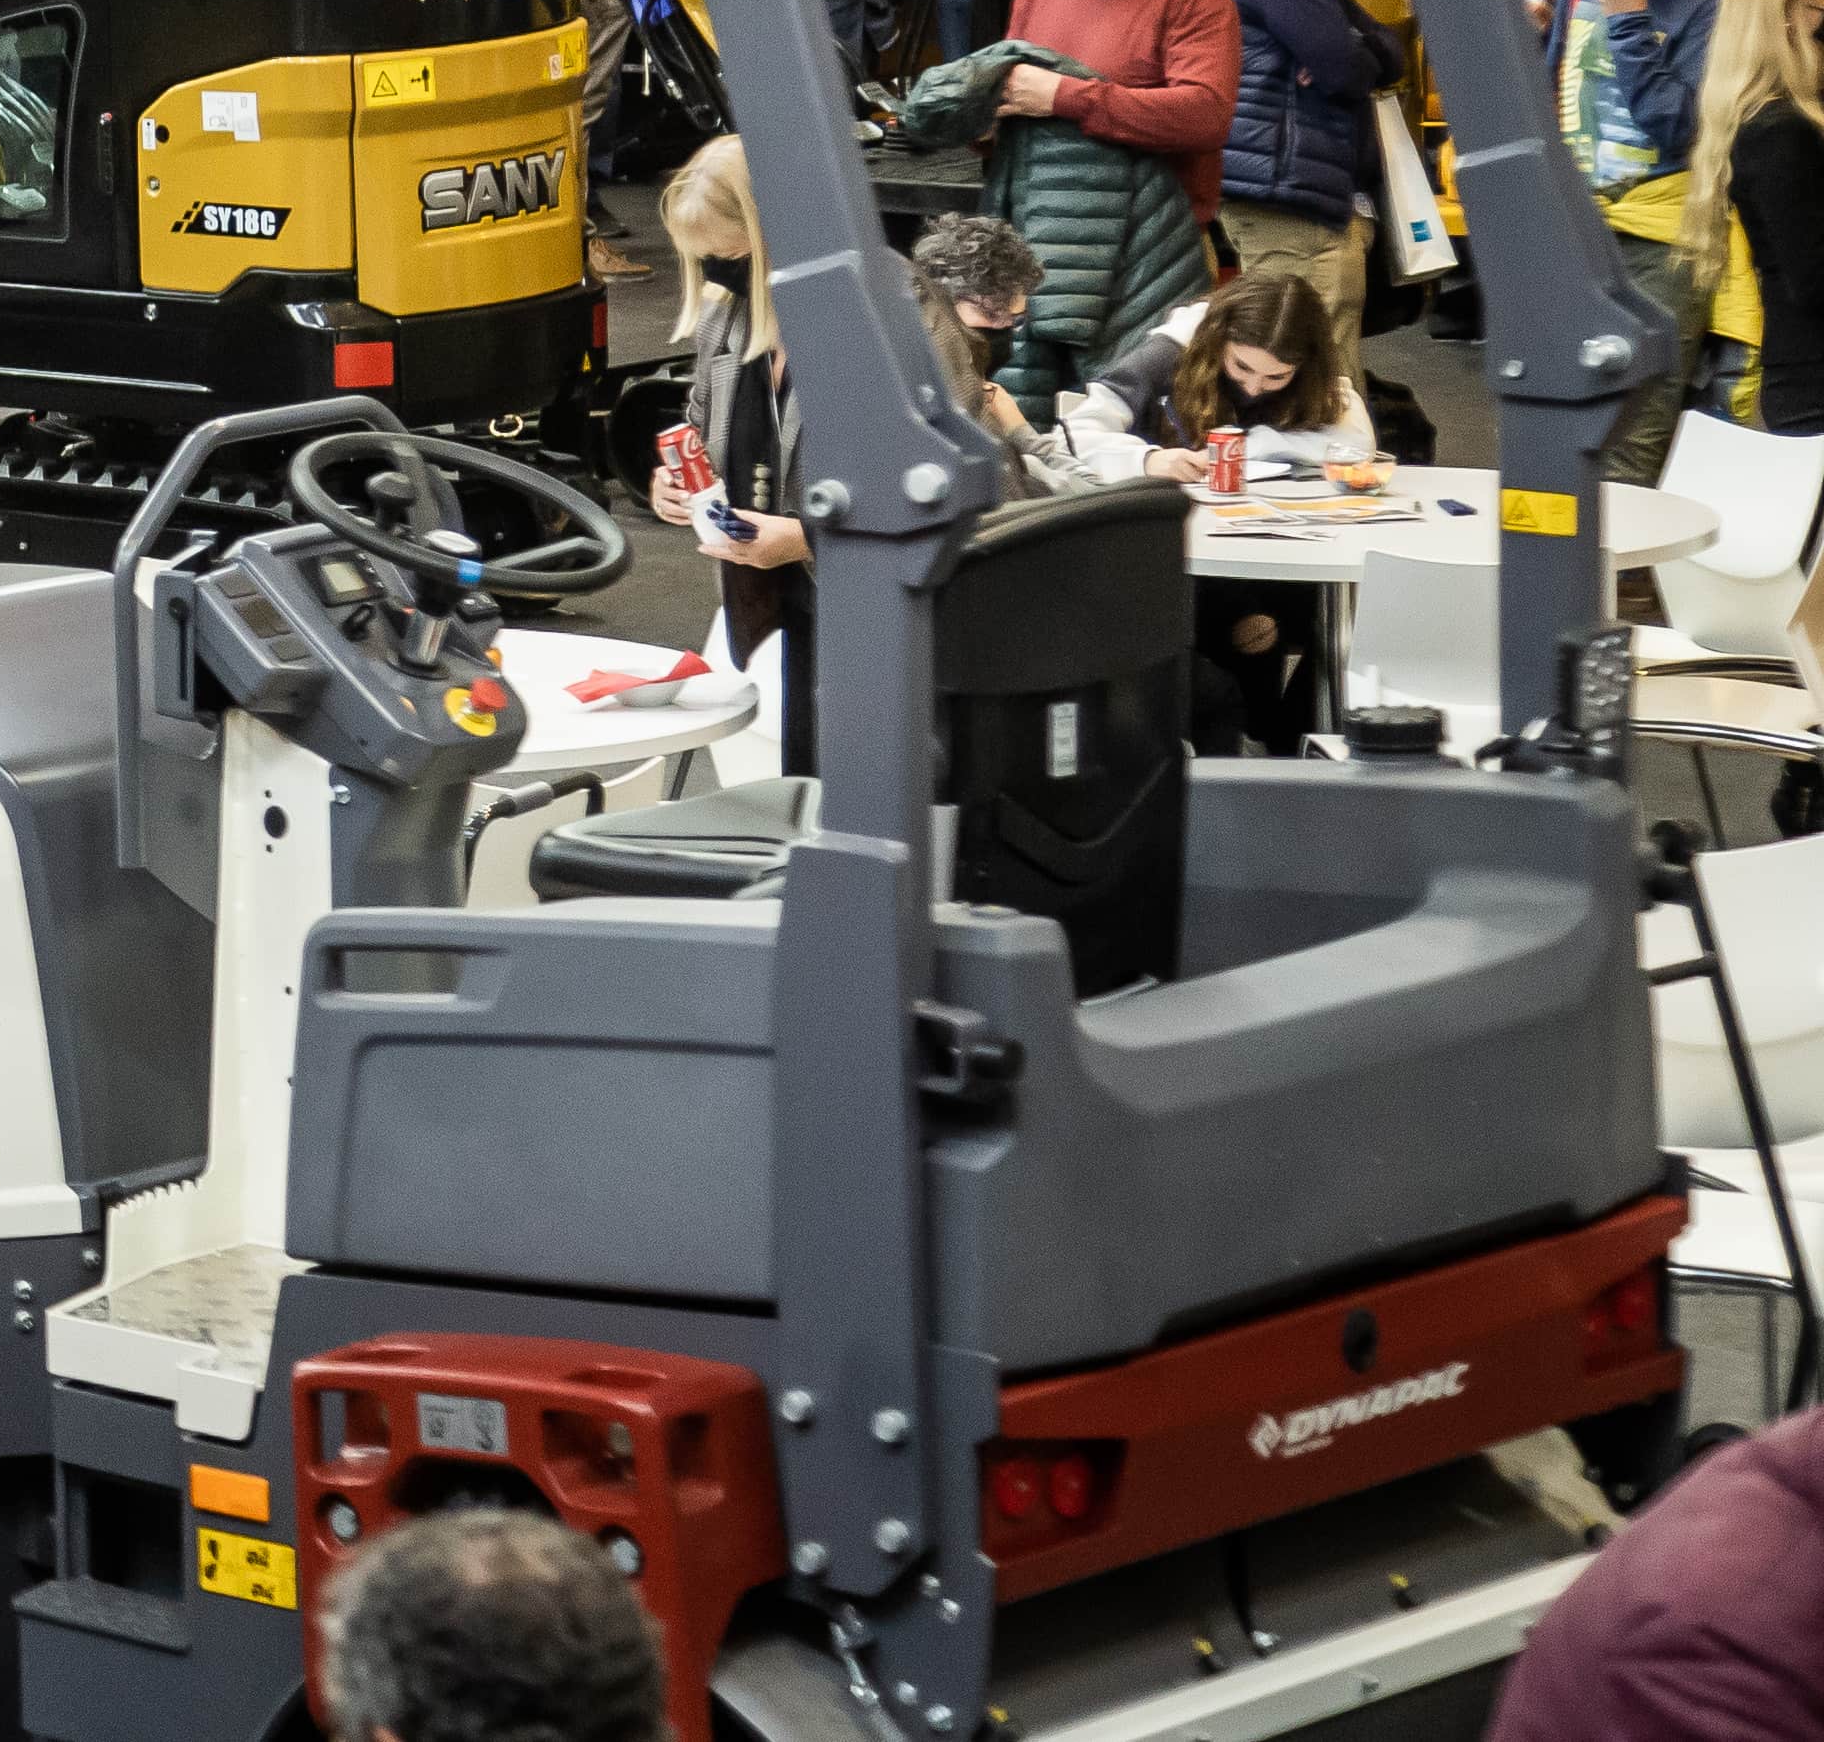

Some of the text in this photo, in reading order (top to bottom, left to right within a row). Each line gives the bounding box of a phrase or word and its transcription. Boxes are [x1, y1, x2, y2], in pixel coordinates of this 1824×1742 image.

[202, 205, 277, 237] SY18C
[420, 148, 567, 233] SANY
[1282, 1361, 1470, 1443] DYNAPAC
